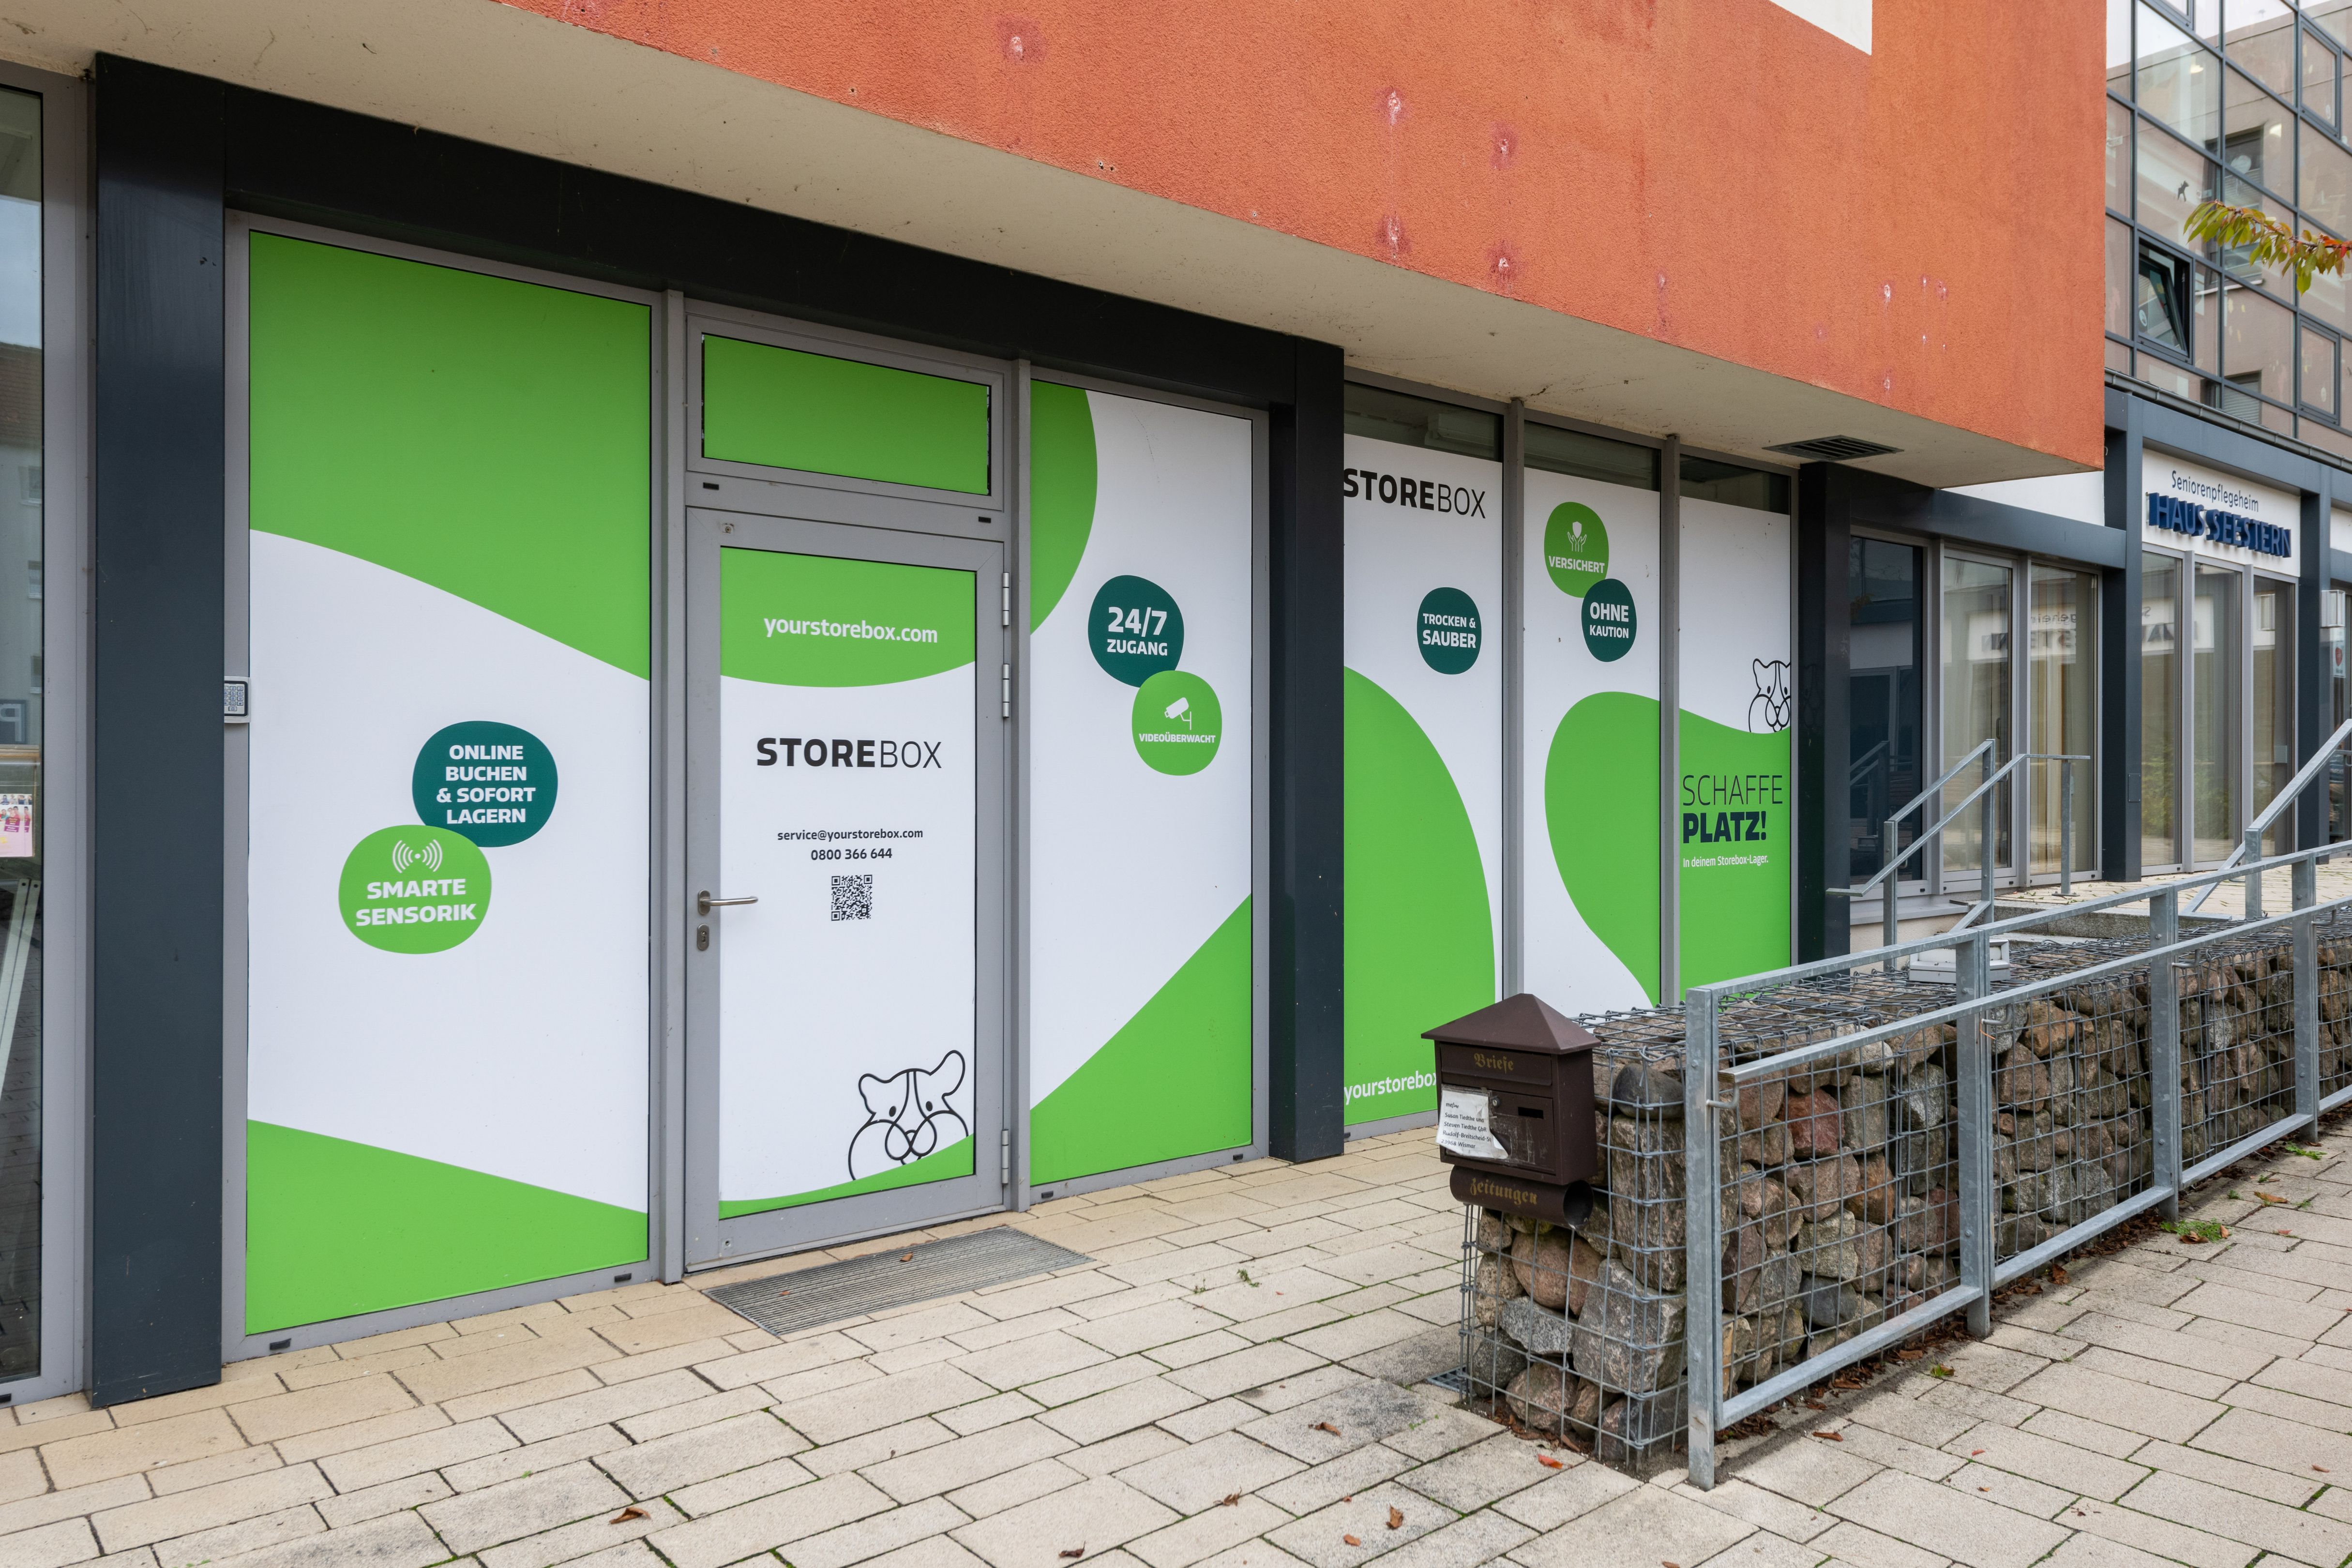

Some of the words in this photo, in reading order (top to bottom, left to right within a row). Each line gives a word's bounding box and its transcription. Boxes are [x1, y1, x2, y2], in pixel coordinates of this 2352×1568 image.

[1344, 468, 1486, 519] STOREBOX
[2172, 470, 2259, 513] Seniorenpflegeheim
[2149, 492, 2204, 536] HAUS
[2206, 509, 2291, 558] SEESTERN
[1549, 555, 1605, 573] VERSICHERT
[1422, 613, 1467, 628] TROCKEN
[1469, 618, 1476, 629] &
[1590, 602, 1629, 622] OHNE
[764, 618, 937, 643] yourstorebox.com
[1108, 606, 1167, 637] 24/7
[1422, 630, 1477, 648] SAUBER
[1589, 624, 1629, 639] KAUTION
[1107, 639, 1168, 656] ZUGANG
[1138, 732, 1216, 743] VIDEOÜBERWACHT
[449, 745, 524, 760] ONLINE
[756, 738, 942, 769] STOREBOX
[446, 766, 527, 781] BUCHEN
[436, 787, 452, 803] &
[457, 787, 536, 803] SOFORT
[1683, 775, 1783, 806] SCHAFFE
[447, 808, 526, 824] LAGERN
[778, 828, 923, 842] service@yourstorebox.com
[1683, 811, 1766, 844] PLATZ!
[811, 849, 841, 860] 0800
[845, 848, 867, 860] 366
[870, 848, 892, 859] 644
[1683, 858, 1690, 868] In
[1691, 856, 1716, 868] deinem
[1717, 855, 1768, 867] Storebox-Lager.
[367, 878, 467, 900] SMARTE
[356, 903, 477, 927] SENSORIK
[1474, 1053, 1514, 1074] Briefe
